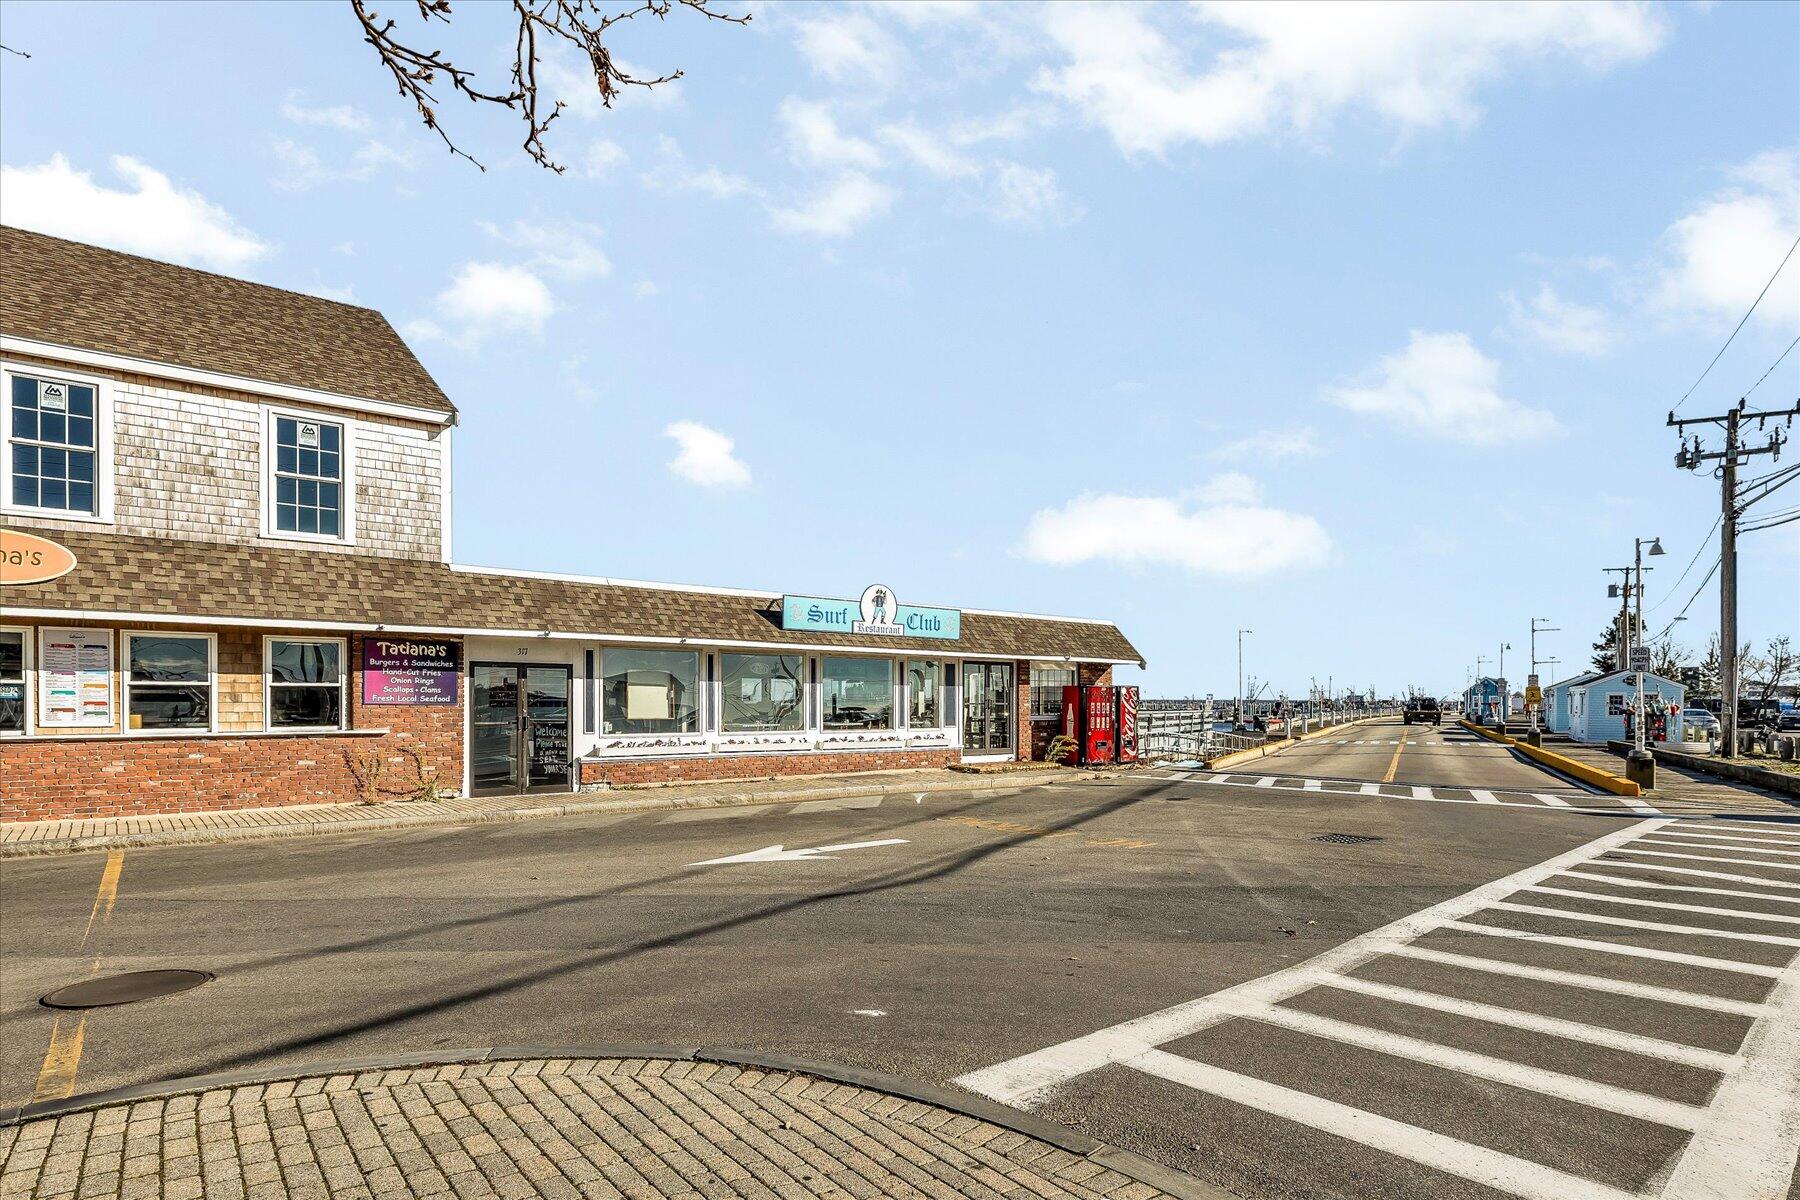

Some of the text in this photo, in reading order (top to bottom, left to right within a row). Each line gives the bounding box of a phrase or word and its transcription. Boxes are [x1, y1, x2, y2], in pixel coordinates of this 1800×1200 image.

[807, 604, 941, 633] Surf Club
[857, 622, 901, 635] Restaurant
[376, 641, 448, 657] Tatiana's
[369, 658, 400, 668] Burgers
[411, 659, 454, 668] Sandwiches
[382, 668, 442, 677] Hand-Cut Fries
[390, 676, 435, 686] Onion Rings
[382, 686, 442, 694] Scallops Clams
[372, 694, 395, 702] Fresh
[420, 695, 451, 703] Seafood
